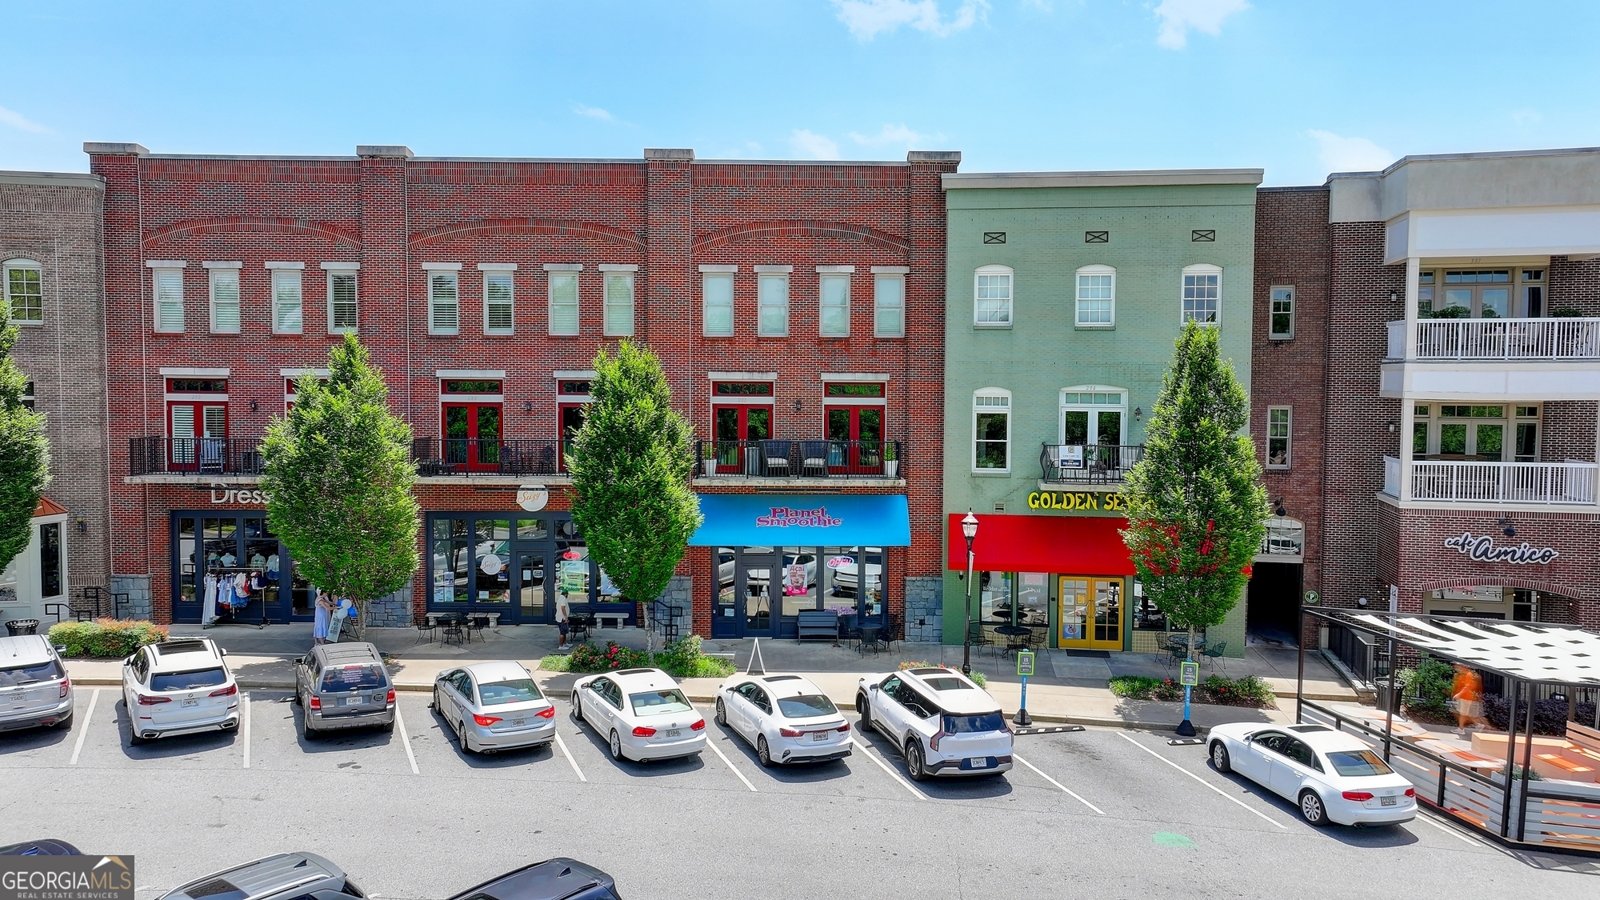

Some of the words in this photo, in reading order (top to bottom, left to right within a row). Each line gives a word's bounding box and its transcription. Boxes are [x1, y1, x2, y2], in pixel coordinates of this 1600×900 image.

[1028, 491, 1099, 511] GOLDEN
[769, 506, 827, 518] Planet
[756, 514, 842, 527] Smoothie
[1445, 532, 1475, 553] cafe
[1470, 536, 1559, 564] Amico
